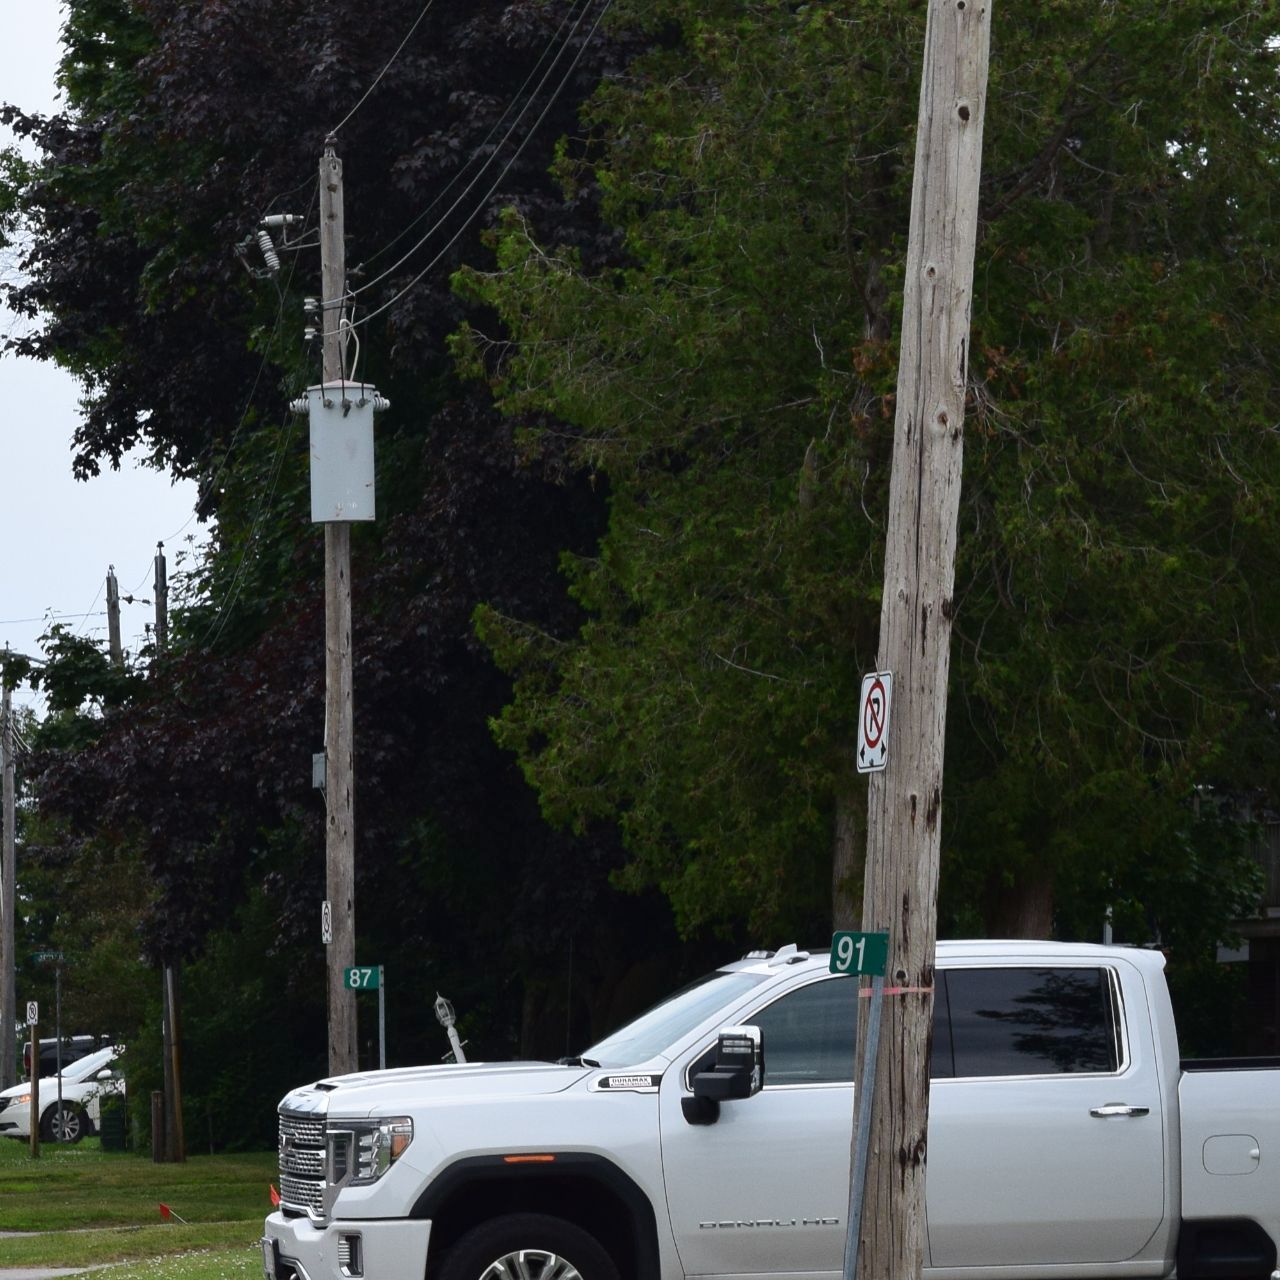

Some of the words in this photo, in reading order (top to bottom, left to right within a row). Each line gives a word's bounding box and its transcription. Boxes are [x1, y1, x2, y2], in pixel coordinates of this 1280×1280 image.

[836, 936, 865, 971] 91
[349, 969, 372, 987] 87
[699, 1218, 796, 1229] DENALI
[802, 1217, 840, 1226] HD
